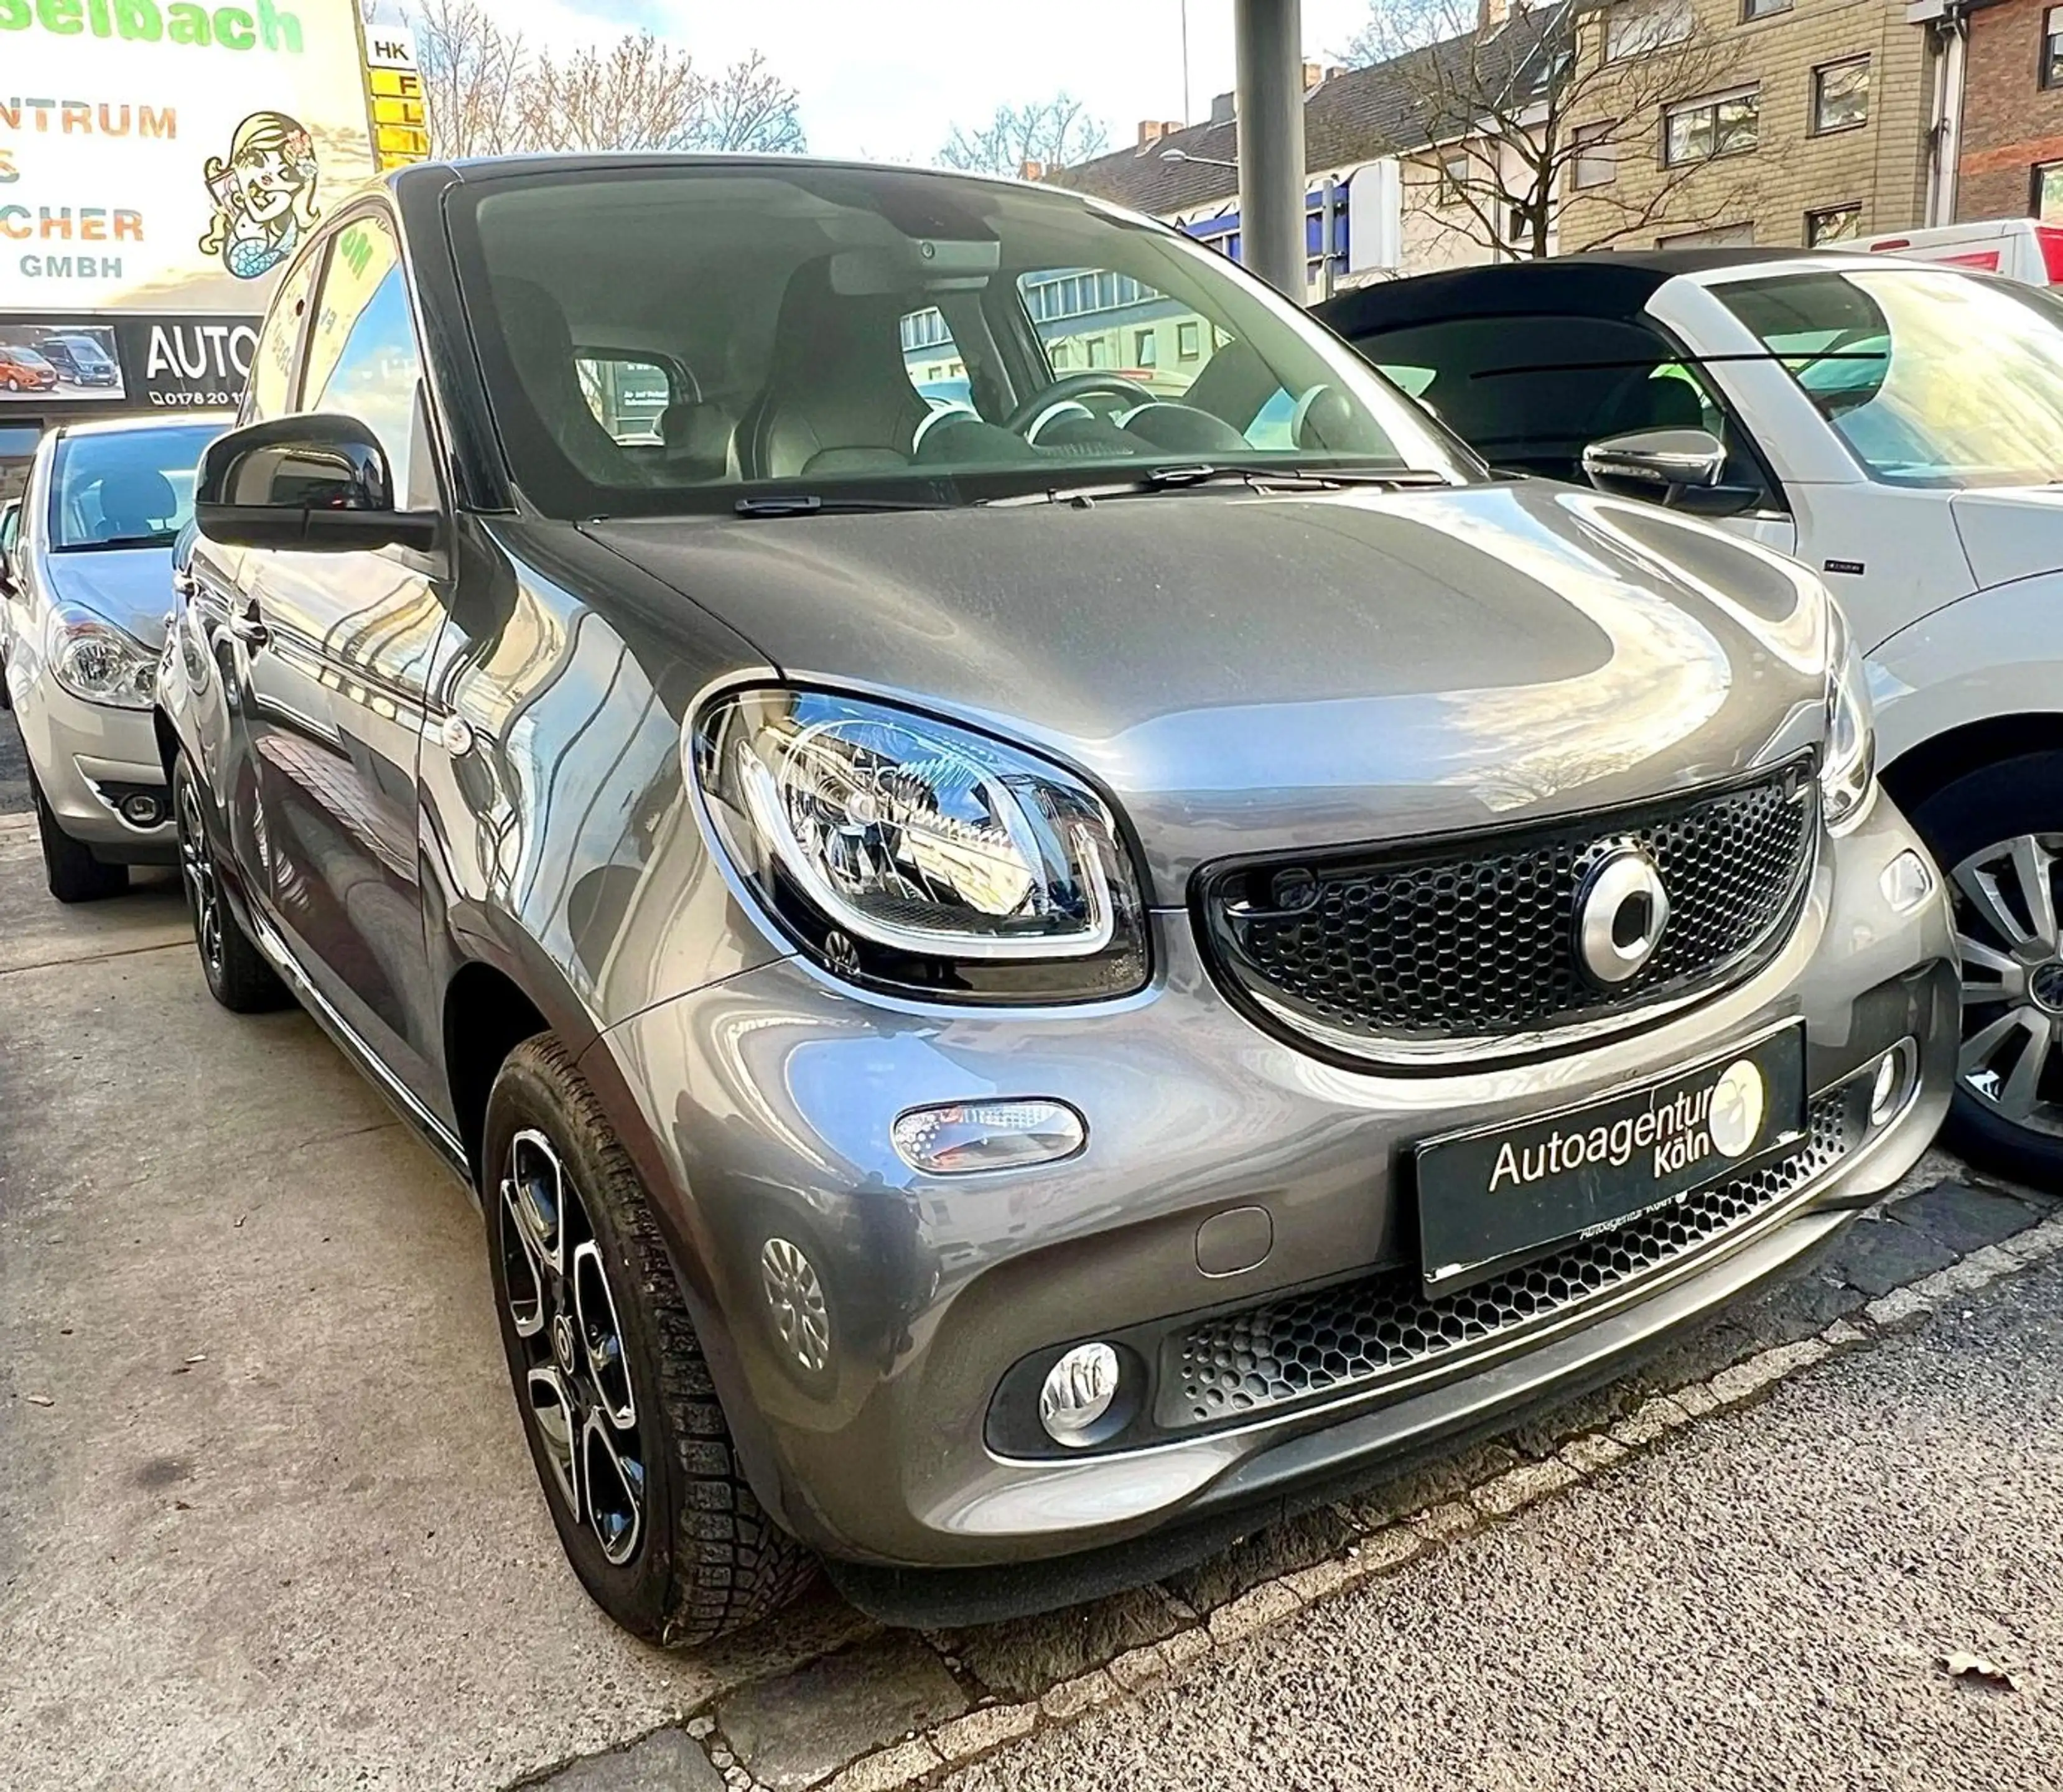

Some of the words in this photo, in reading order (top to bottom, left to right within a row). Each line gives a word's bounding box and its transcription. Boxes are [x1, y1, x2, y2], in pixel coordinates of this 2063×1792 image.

[375, 40, 410, 61] HK
[19, 254, 123, 278] GMBH
[146, 325, 259, 379] AUTO
[164, 391, 205, 405] 0178
[207, 392, 230, 404] 20
[1488, 1085, 1714, 1192] Autoagentur
[1653, 1127, 1710, 1178] Köln
